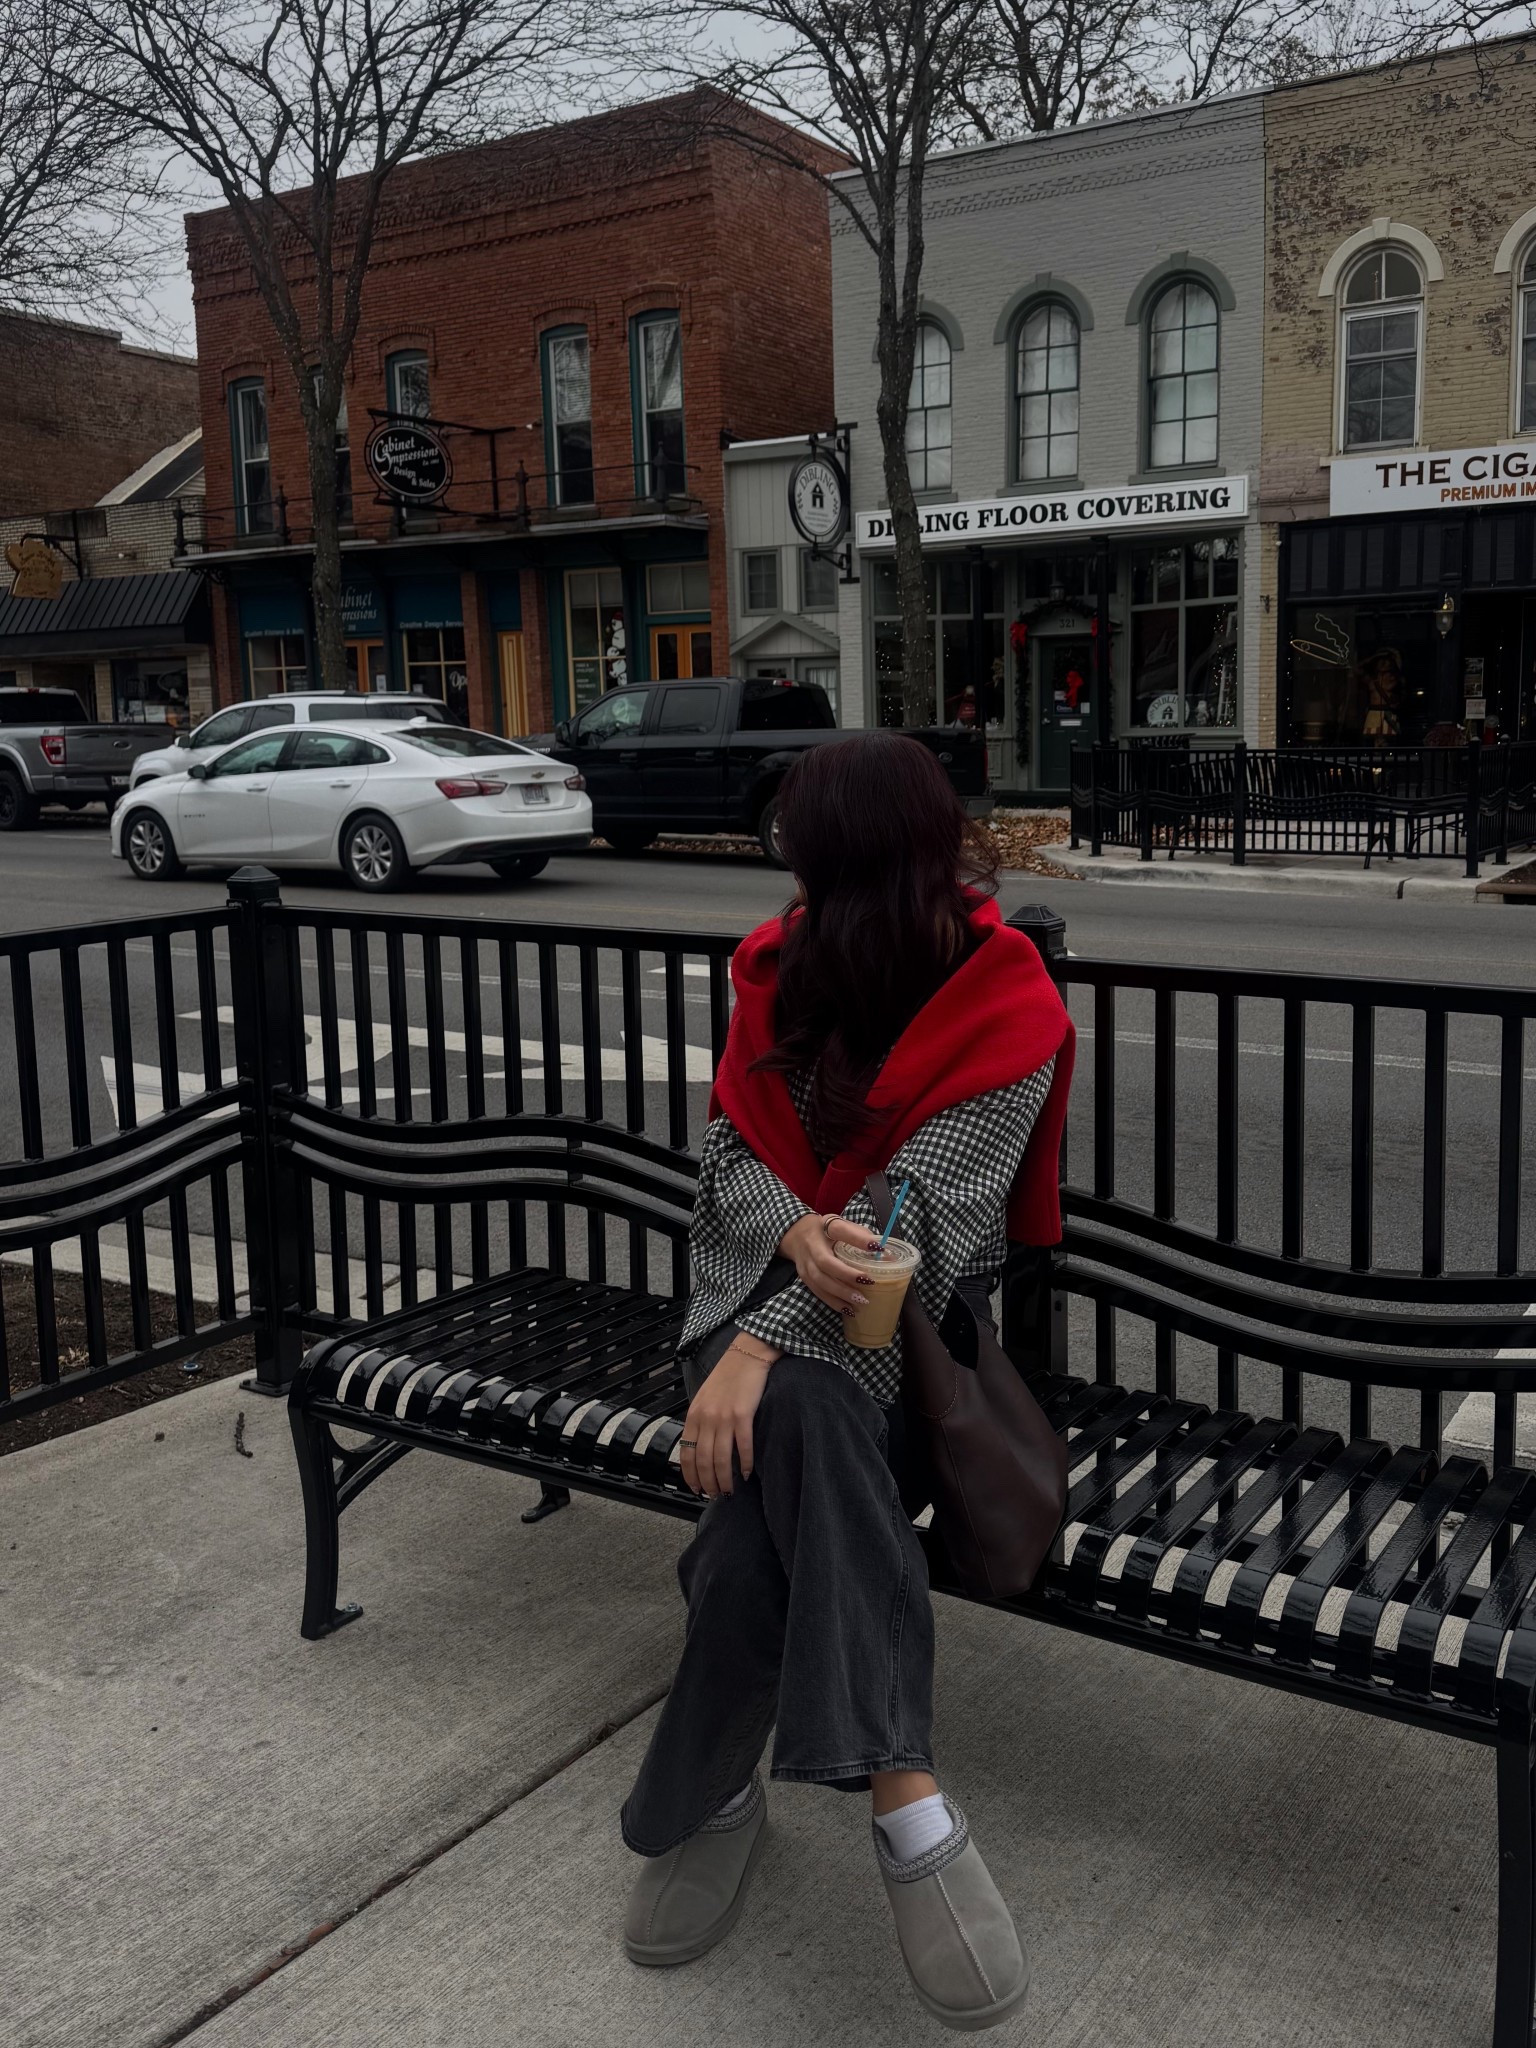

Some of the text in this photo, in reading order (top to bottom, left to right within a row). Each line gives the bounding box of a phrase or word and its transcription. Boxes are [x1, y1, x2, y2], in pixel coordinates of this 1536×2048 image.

[374, 436, 415, 462] Cabinet
[381, 446, 440, 475] Impressions
[393, 465, 416, 479] Design
[799, 467, 836, 495] DIBLING
[1375, 452, 1536, 488] THE CIG
[1440, 481, 1536, 502] PREMIUM IM
[867, 486, 1231, 538] DIING FLOOR COVERING
[1059, 618, 1075, 628] 321
[1152, 695, 1179, 710] DIBLI
